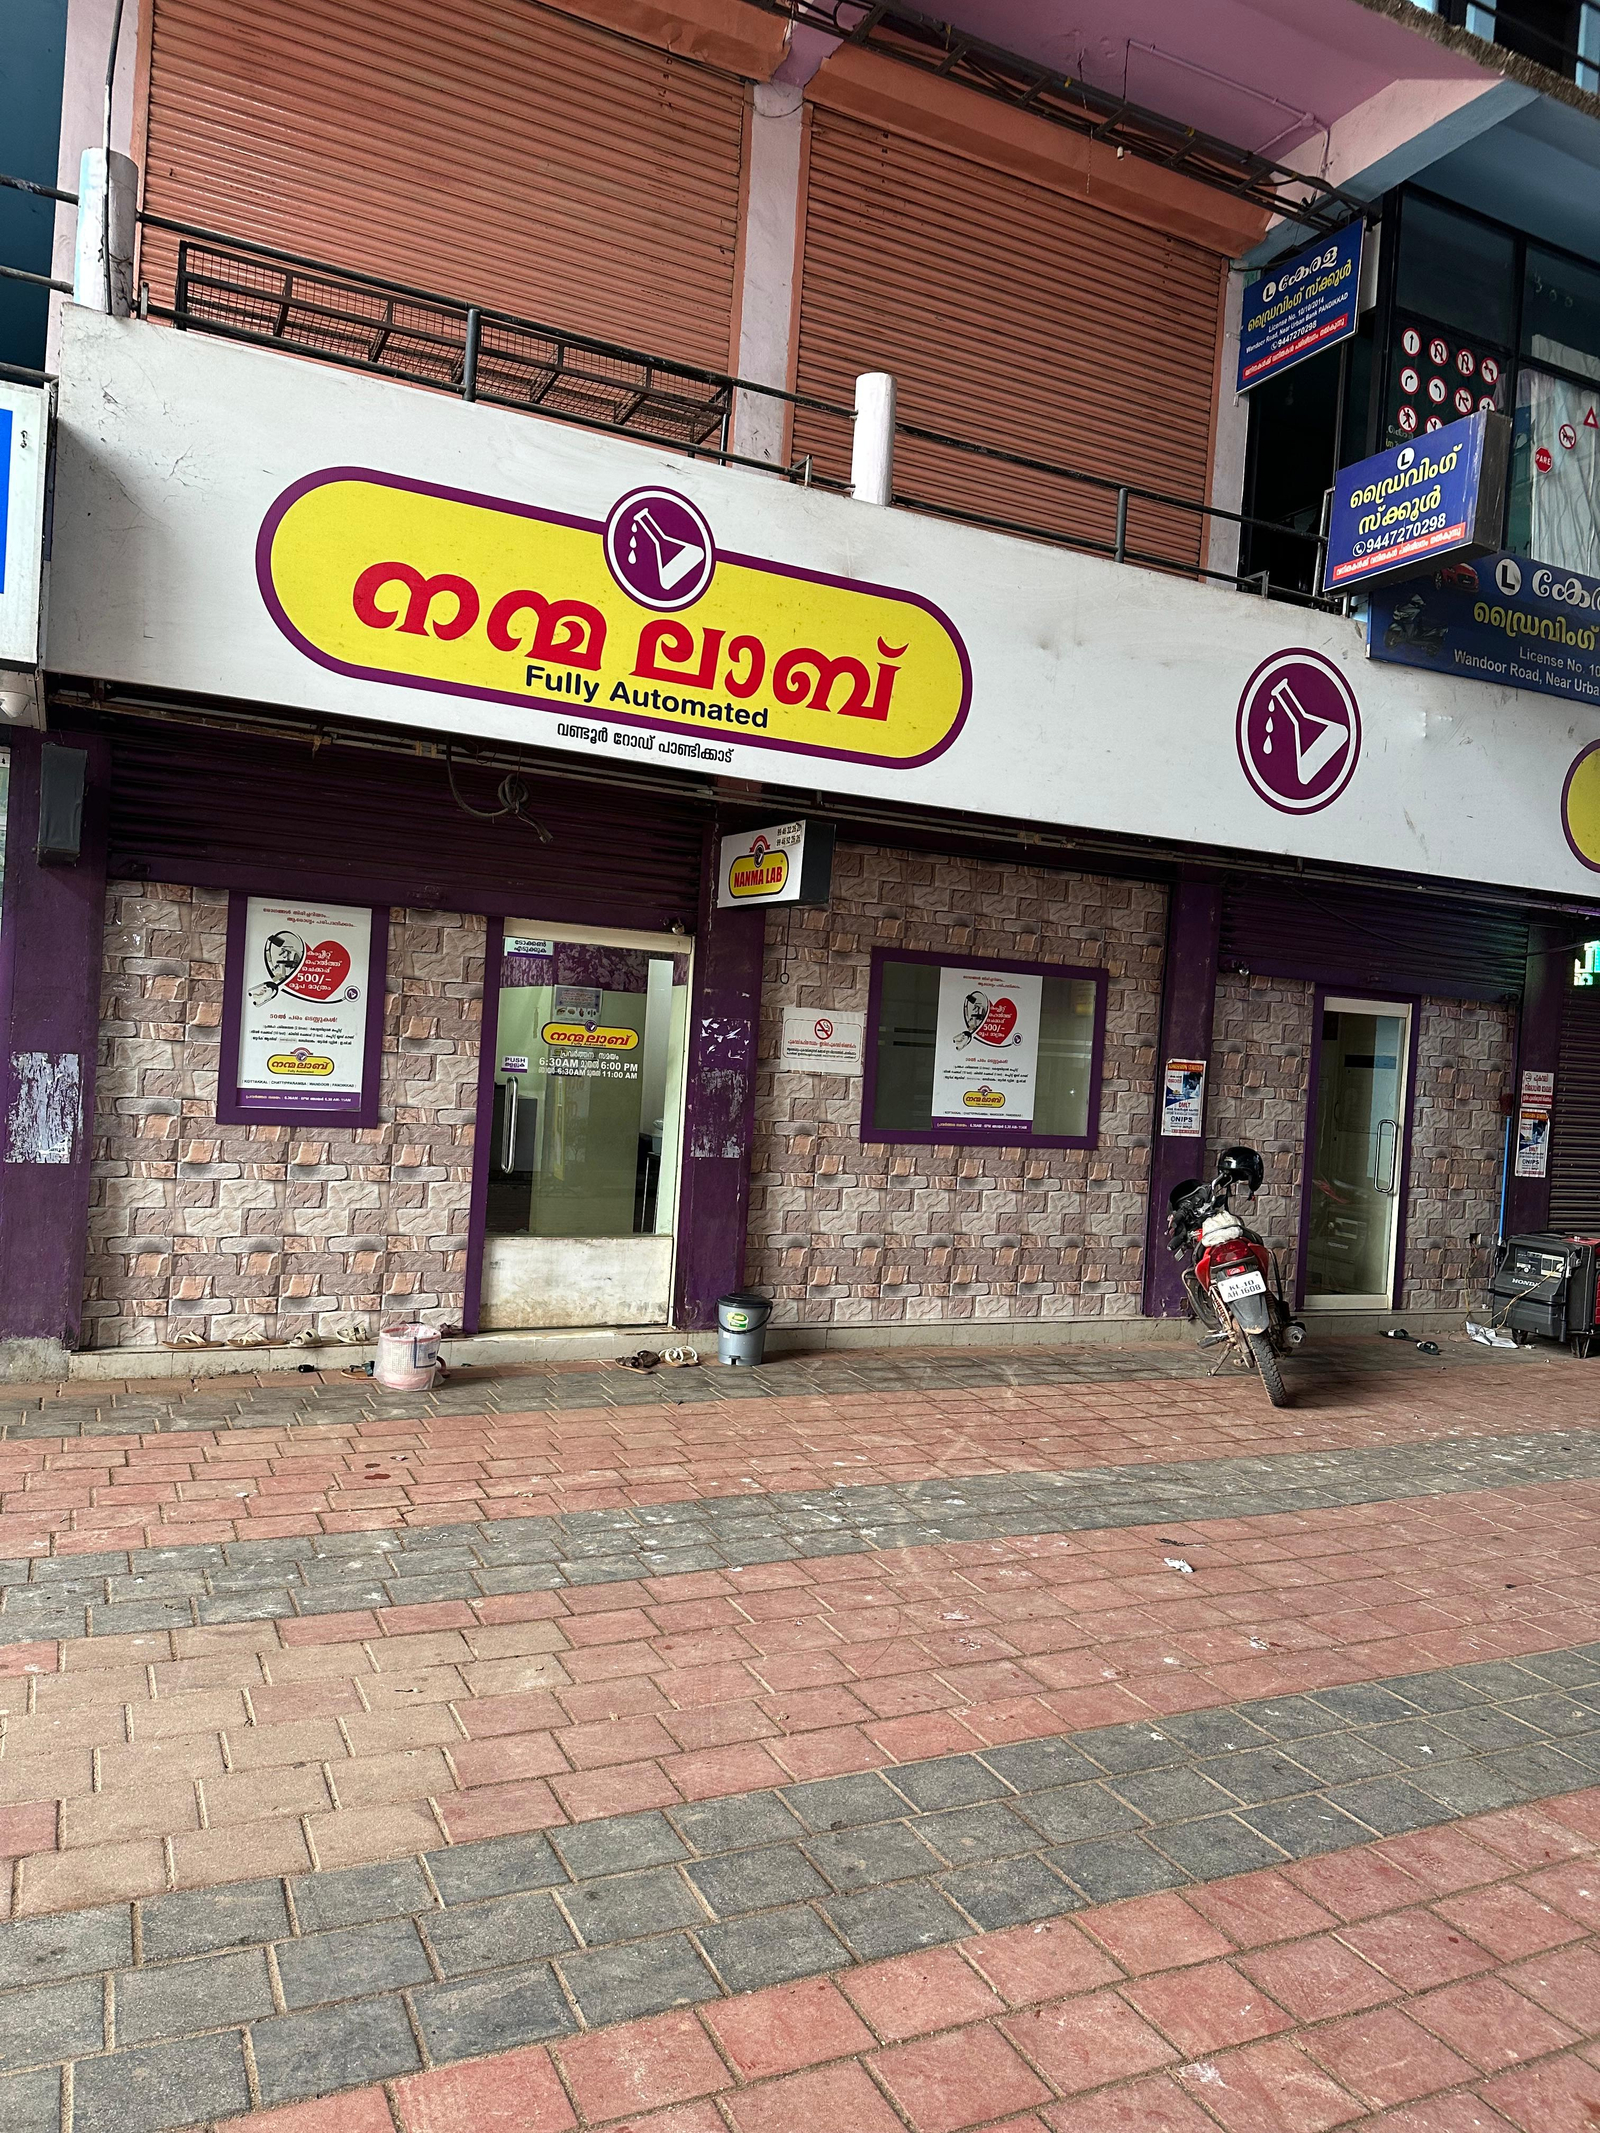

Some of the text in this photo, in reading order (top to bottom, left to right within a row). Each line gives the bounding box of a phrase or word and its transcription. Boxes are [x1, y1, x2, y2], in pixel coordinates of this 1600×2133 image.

[1278, 246, 1338, 292] കേരള
[1268, 318, 1288, 333] License
[1279, 325, 1290, 337] Near
[1290, 318, 1305, 332] Urban
[1305, 311, 1318, 322] Bank
[1318, 292, 1349, 314] PANDIKKAD
[1277, 320, 1317, 348] 9447270298
[1536, 454, 1551, 466] PARE
[1350, 443, 1463, 508] ഡ്രൈവിംഗ്
[1366, 513, 1446, 553] 9447270298
[353, 561, 909, 721] നന്മ ലാബ്
[1454, 649, 1507, 673] Wandoor
[1510, 662, 1543, 685] Road,
[1546, 671, 1572, 690] Near
[1519, 646, 1564, 668] License
[1567, 658, 1585, 674] No.
[526, 664, 769, 728] Fully Automated
[613, 732, 656, 751] റോഡ്
[658, 741, 735, 763] പാണ്ടിക്കാട്
[733, 866, 783, 888] NANMA LAB
[297, 973, 332, 985] 500/-
[550, 1031, 632, 1046] നന്മ ലാബ്
[539, 1058, 578, 1068] 6:30AM
[600, 1061, 621, 1071] 6:00
[623, 1063, 638, 1072] PM
[602, 1070, 623, 1078] 11:00
